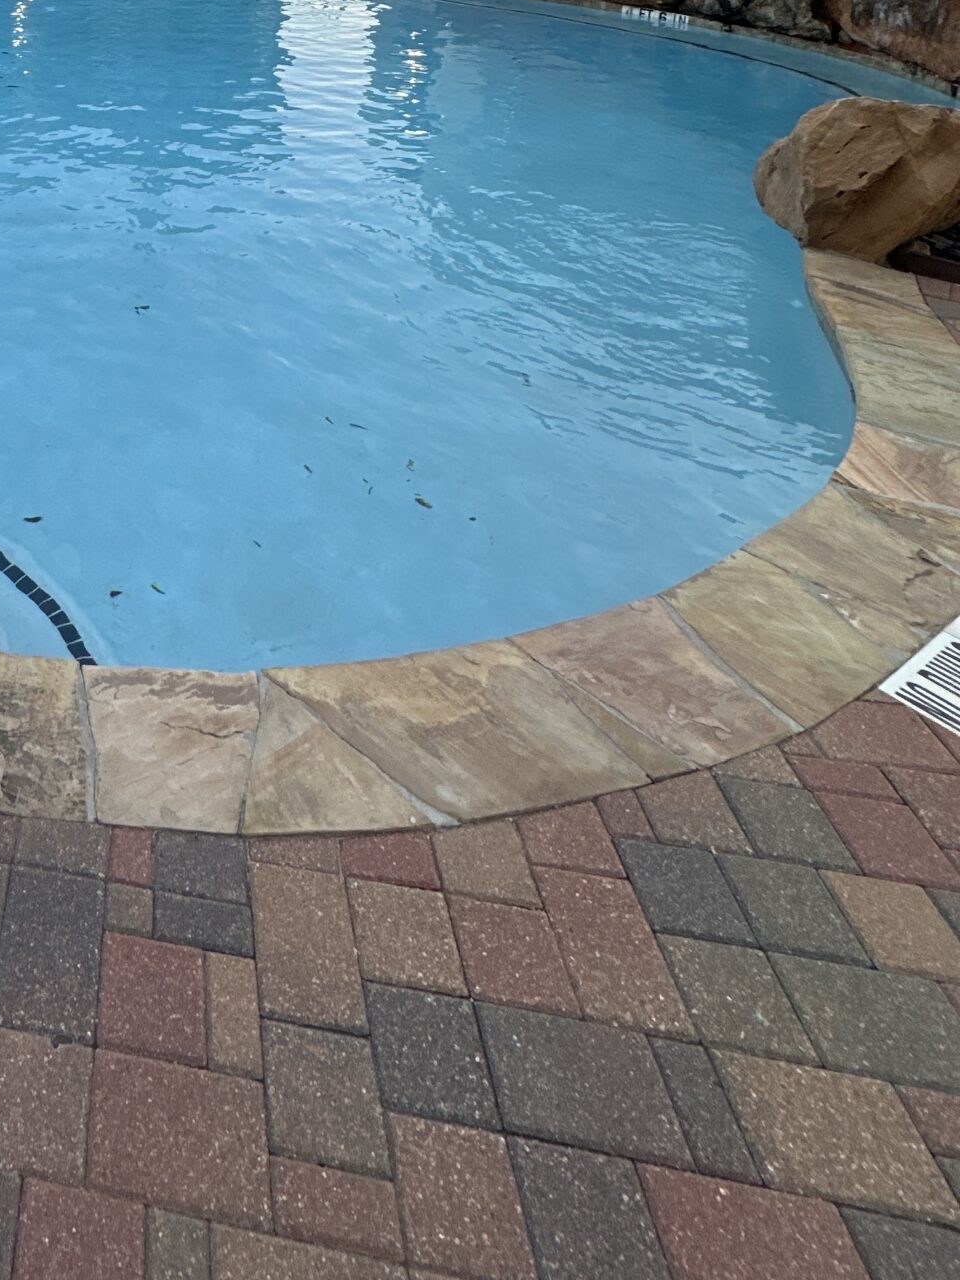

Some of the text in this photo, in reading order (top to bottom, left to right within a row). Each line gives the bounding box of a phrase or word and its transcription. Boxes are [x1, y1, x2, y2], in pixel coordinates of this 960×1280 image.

[639, 8, 654, 18] FT
[659, 11, 667, 21] 6
[673, 13, 686, 23] IN
[895, 681, 960, 733] NO
